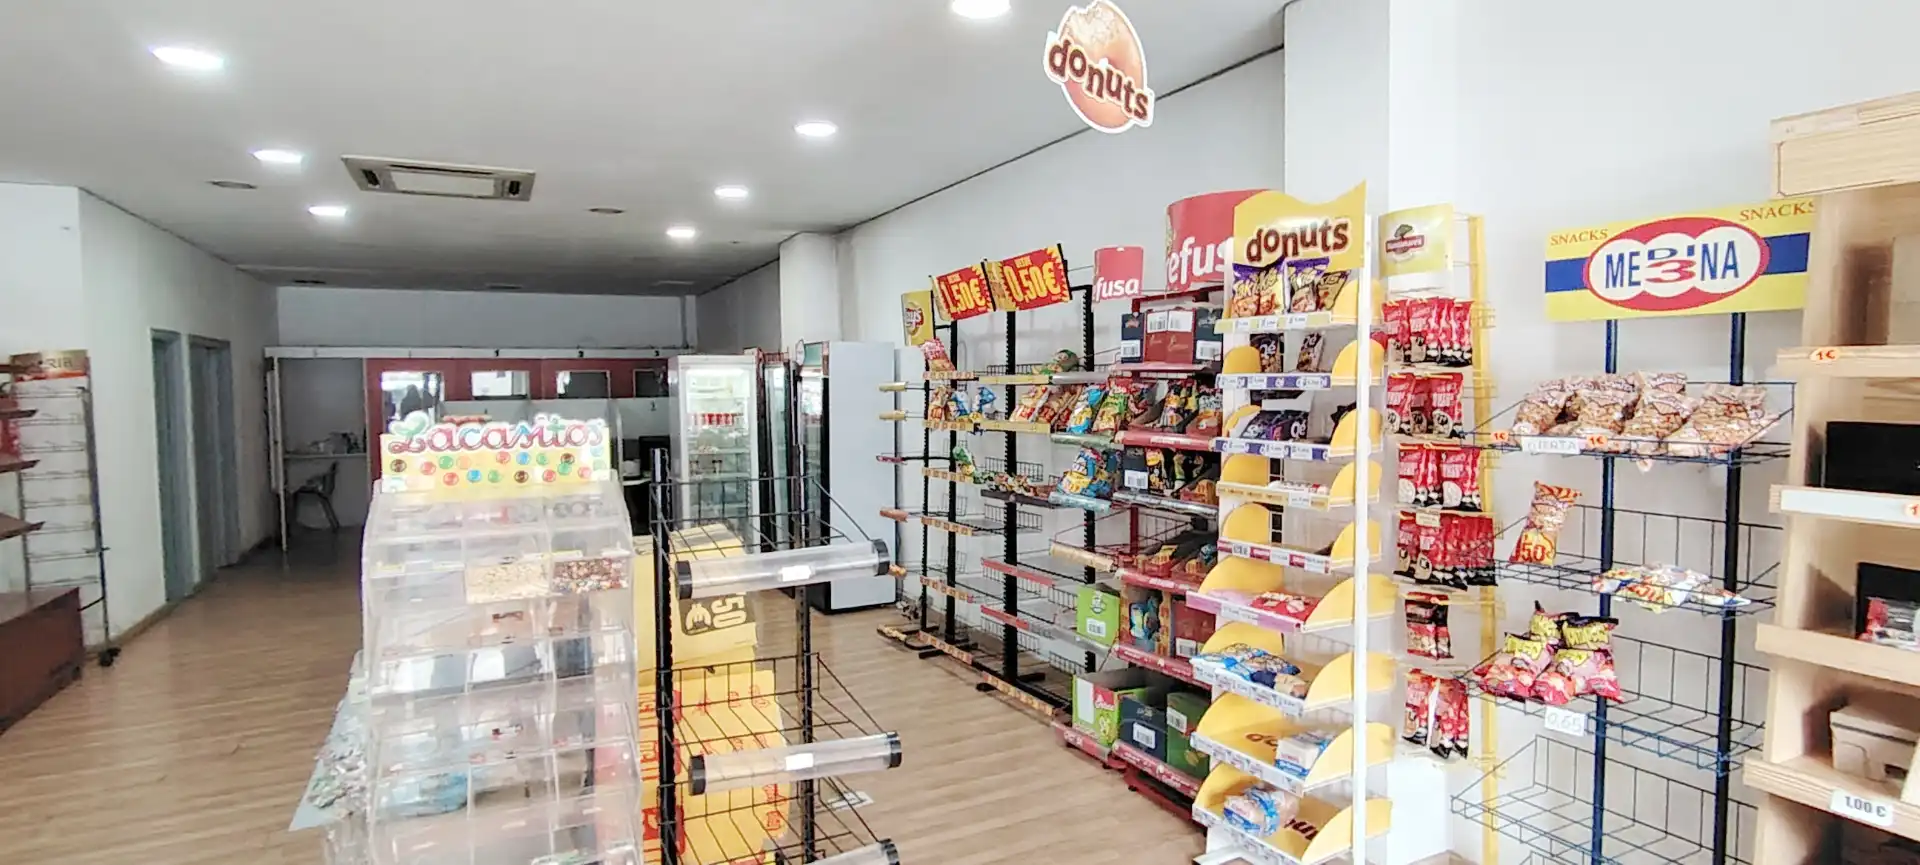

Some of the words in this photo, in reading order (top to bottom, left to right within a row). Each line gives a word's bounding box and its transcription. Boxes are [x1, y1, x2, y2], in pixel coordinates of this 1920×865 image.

[1048, 39, 1149, 121] donuts
[1245, 217, 1350, 262] donuts
[1550, 228, 1609, 246] SNACKS
[1003, 261, 1061, 304] 0,50€
[941, 278, 986, 315] 1,50€
[1816, 350, 1836, 361] 1€
[387, 411, 605, 455] Lacasitos
[1494, 431, 1506, 441] 1€
[1589, 435, 1605, 447] 1€
[1876, 805, 1887, 818] €
